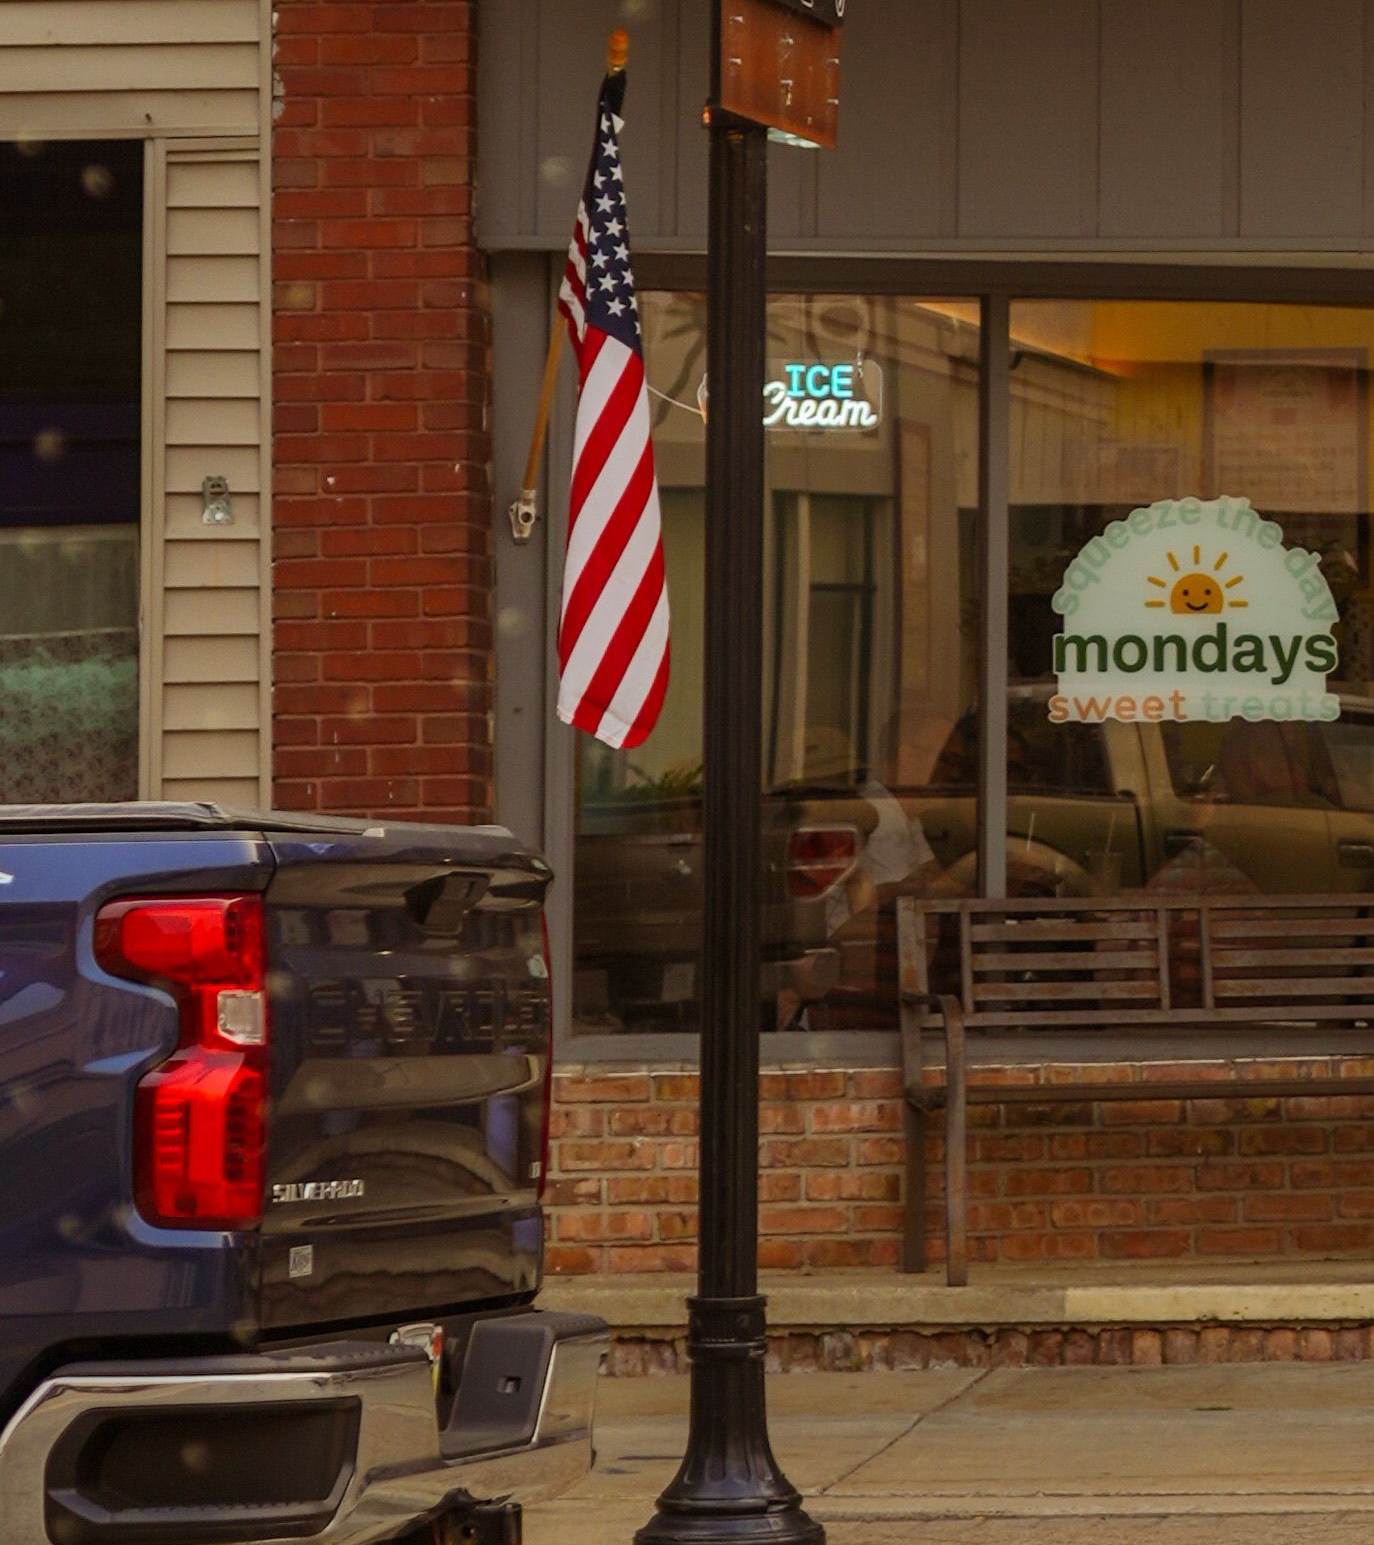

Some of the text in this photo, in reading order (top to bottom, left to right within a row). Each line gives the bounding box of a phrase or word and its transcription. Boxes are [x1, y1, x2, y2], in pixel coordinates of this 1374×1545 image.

[785, 364, 854, 398] ICE
[1053, 495, 1338, 621] squeeze the day
[1054, 622, 1337, 685] mondays
[1050, 690, 1338, 720] sweet treats
[272, 1179, 365, 1203] SILVERADO
